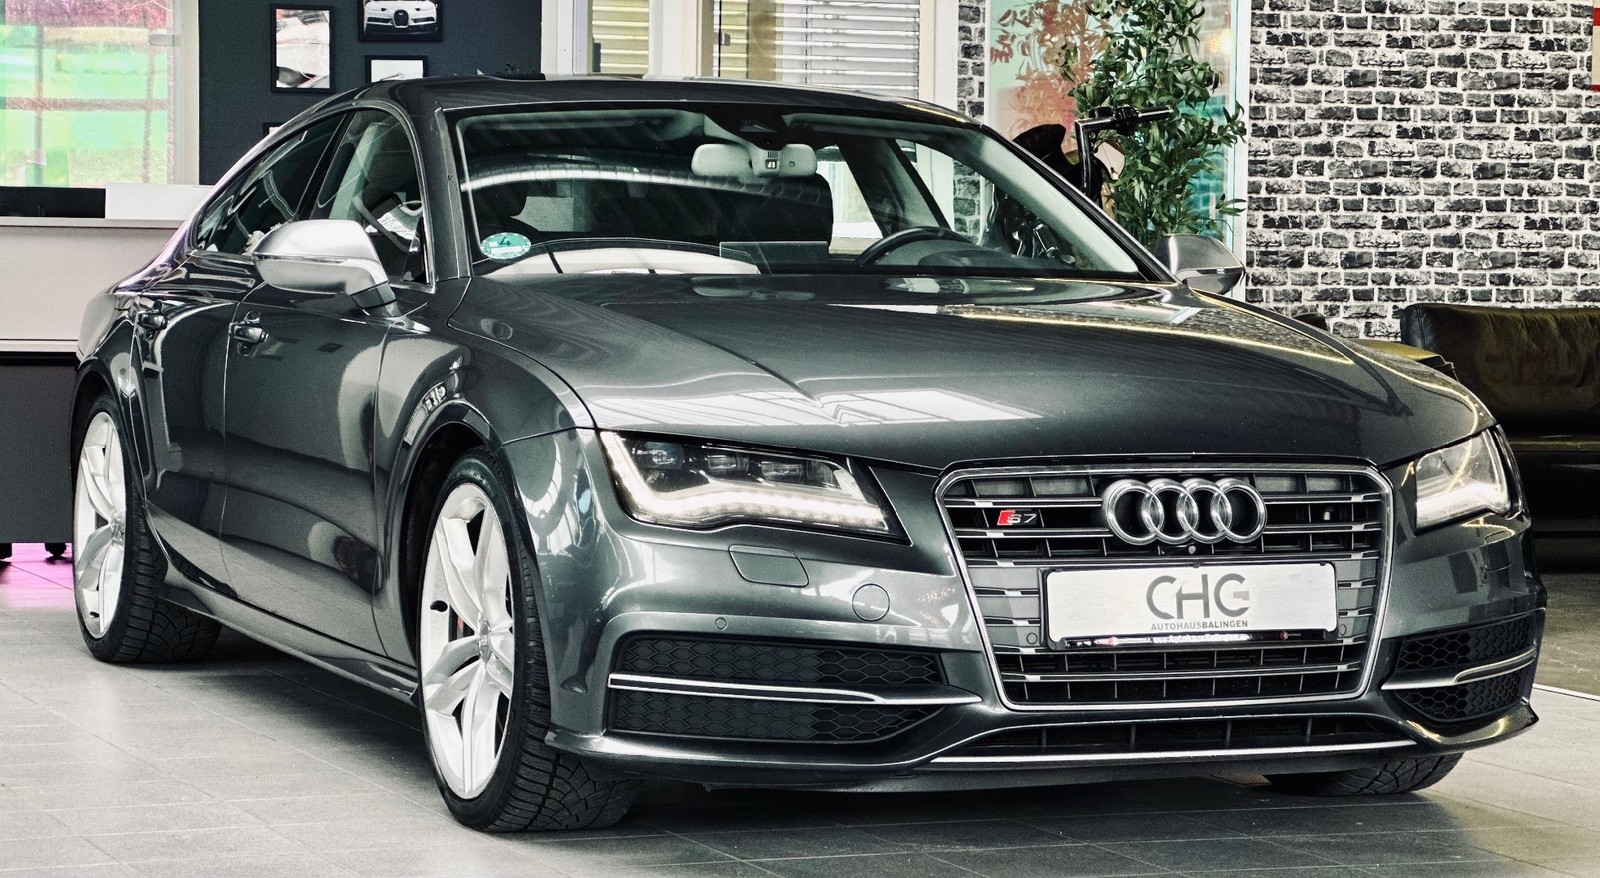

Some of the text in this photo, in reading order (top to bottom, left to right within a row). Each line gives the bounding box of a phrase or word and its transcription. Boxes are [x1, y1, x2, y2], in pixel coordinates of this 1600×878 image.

[499, 236, 512, 246] 4
[1007, 513, 1037, 524] S7
[1146, 573, 1250, 620] CHG
[1151, 620, 1248, 631] AUTOHAUSBALINGEN
